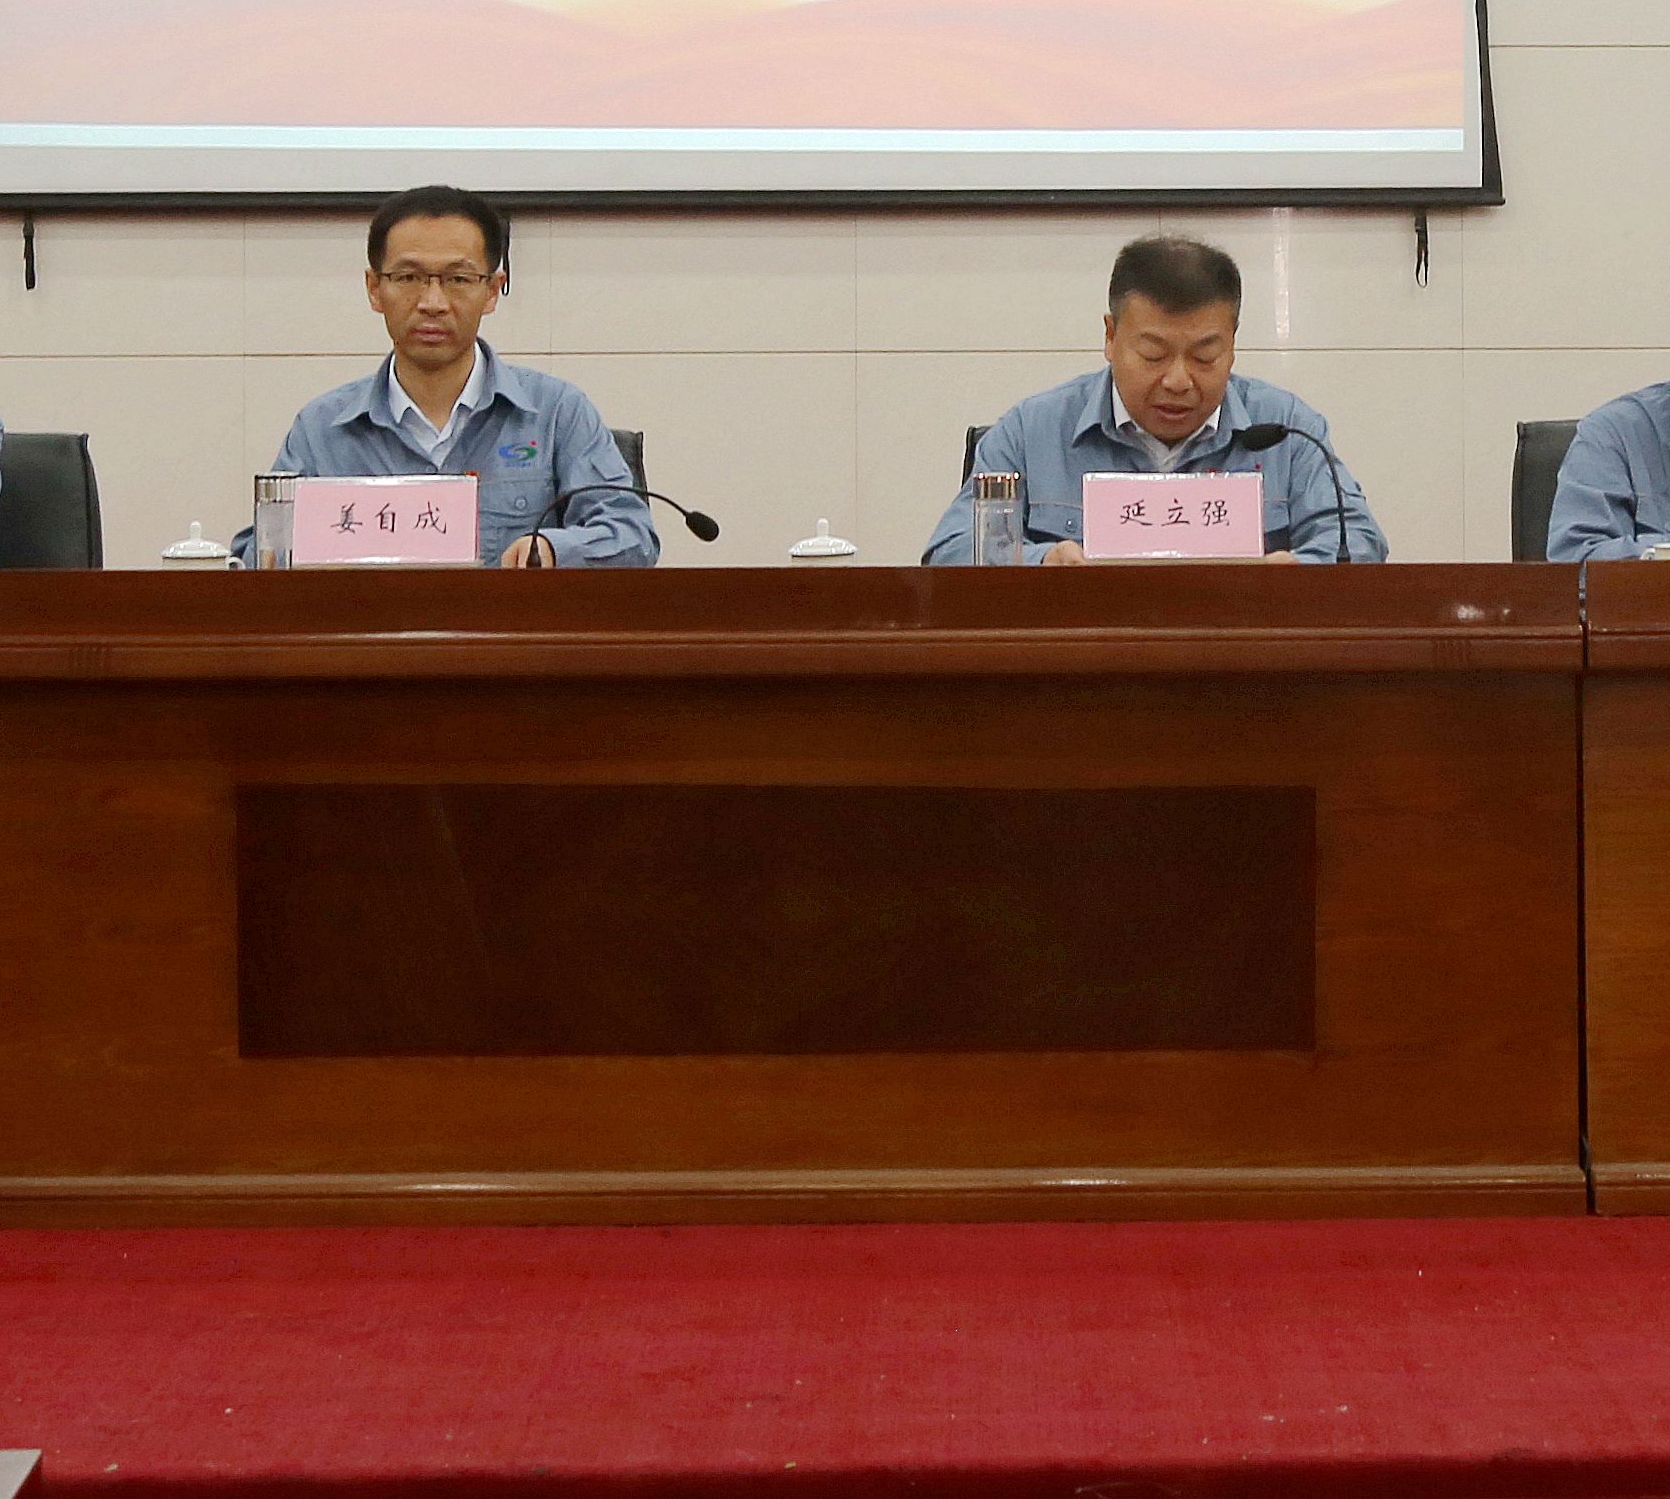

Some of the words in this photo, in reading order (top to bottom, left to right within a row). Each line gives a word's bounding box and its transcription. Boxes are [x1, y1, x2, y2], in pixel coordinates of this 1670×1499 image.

[330, 501, 448, 535] 姜自成
[1119, 497, 1231, 528] 延立强
